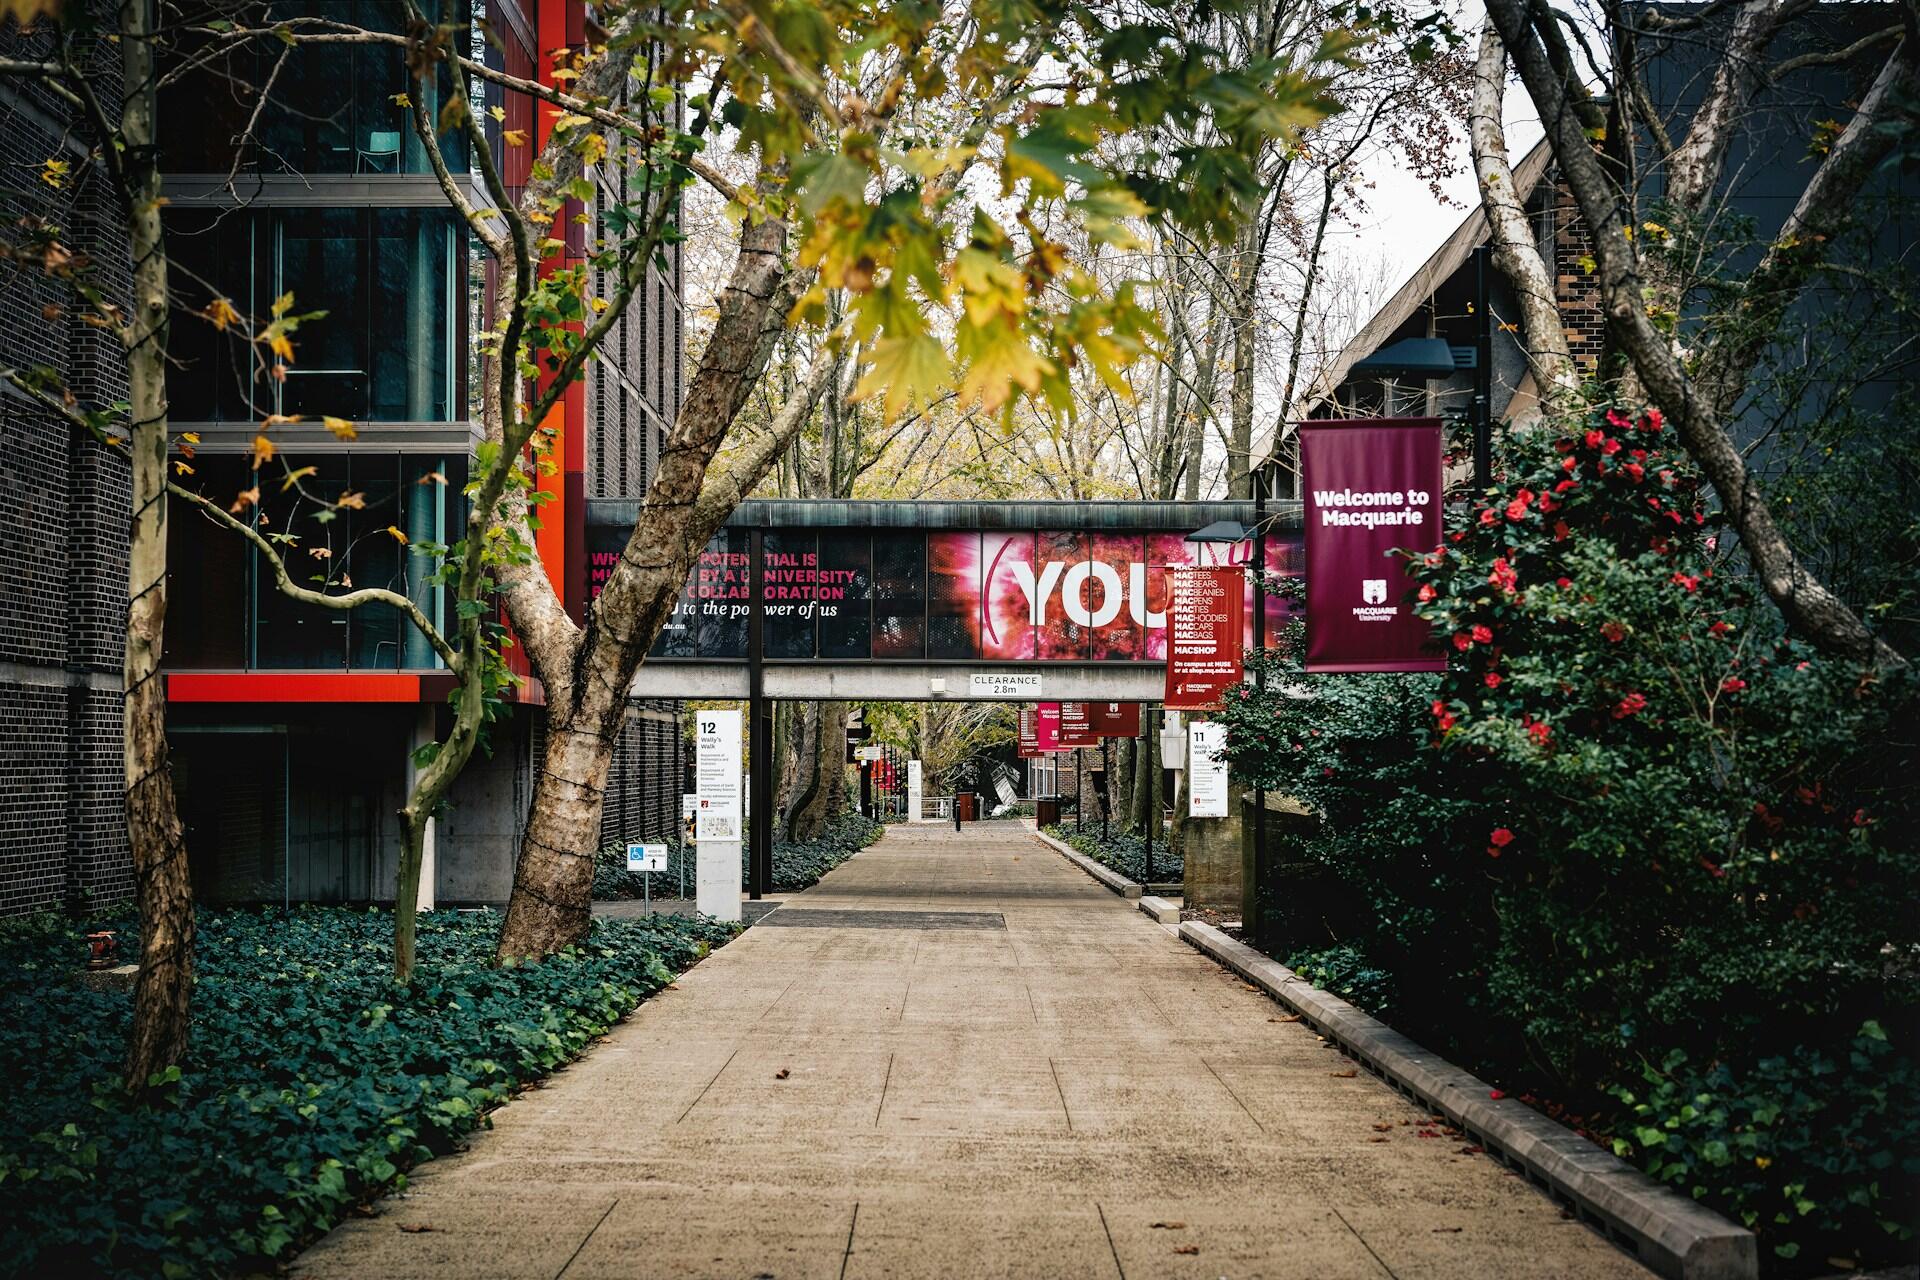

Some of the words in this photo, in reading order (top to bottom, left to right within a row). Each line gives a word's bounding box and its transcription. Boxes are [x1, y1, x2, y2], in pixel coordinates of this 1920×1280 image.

[1313, 488, 1403, 507] Welcome
[1407, 489, 1430, 506] to
[1322, 506, 1423, 530] Macquarie
[803, 553, 817, 566] IS
[700, 569, 720, 583] BY
[724, 570, 736, 583] A
[1174, 571, 1212, 579] MACTEES
[1174, 580, 1218, 588] MACBEARS
[1174, 588, 1225, 597] MACBEANIES
[1174, 597, 1213, 605] MACPENS
[703, 601, 727, 616] the
[730, 604, 794, 619] power
[799, 601, 817, 619] of
[820, 605, 838, 617] us
[1174, 605, 1209, 613] MACTIES
[1352, 606, 1398, 616] MACQUARIE
[1174, 613, 1228, 622] MACHOODIES
[1174, 622, 1213, 630] MACCAPS
[1174, 630, 1213, 639] MACBAGS
[1174, 646, 1217, 655] MACSHOP
[974, 676, 1038, 685] CLEARANCE
[993, 685, 1017, 694] 2.8m
[701, 722, 716, 734] 12
[1194, 732, 1205, 742] 11
